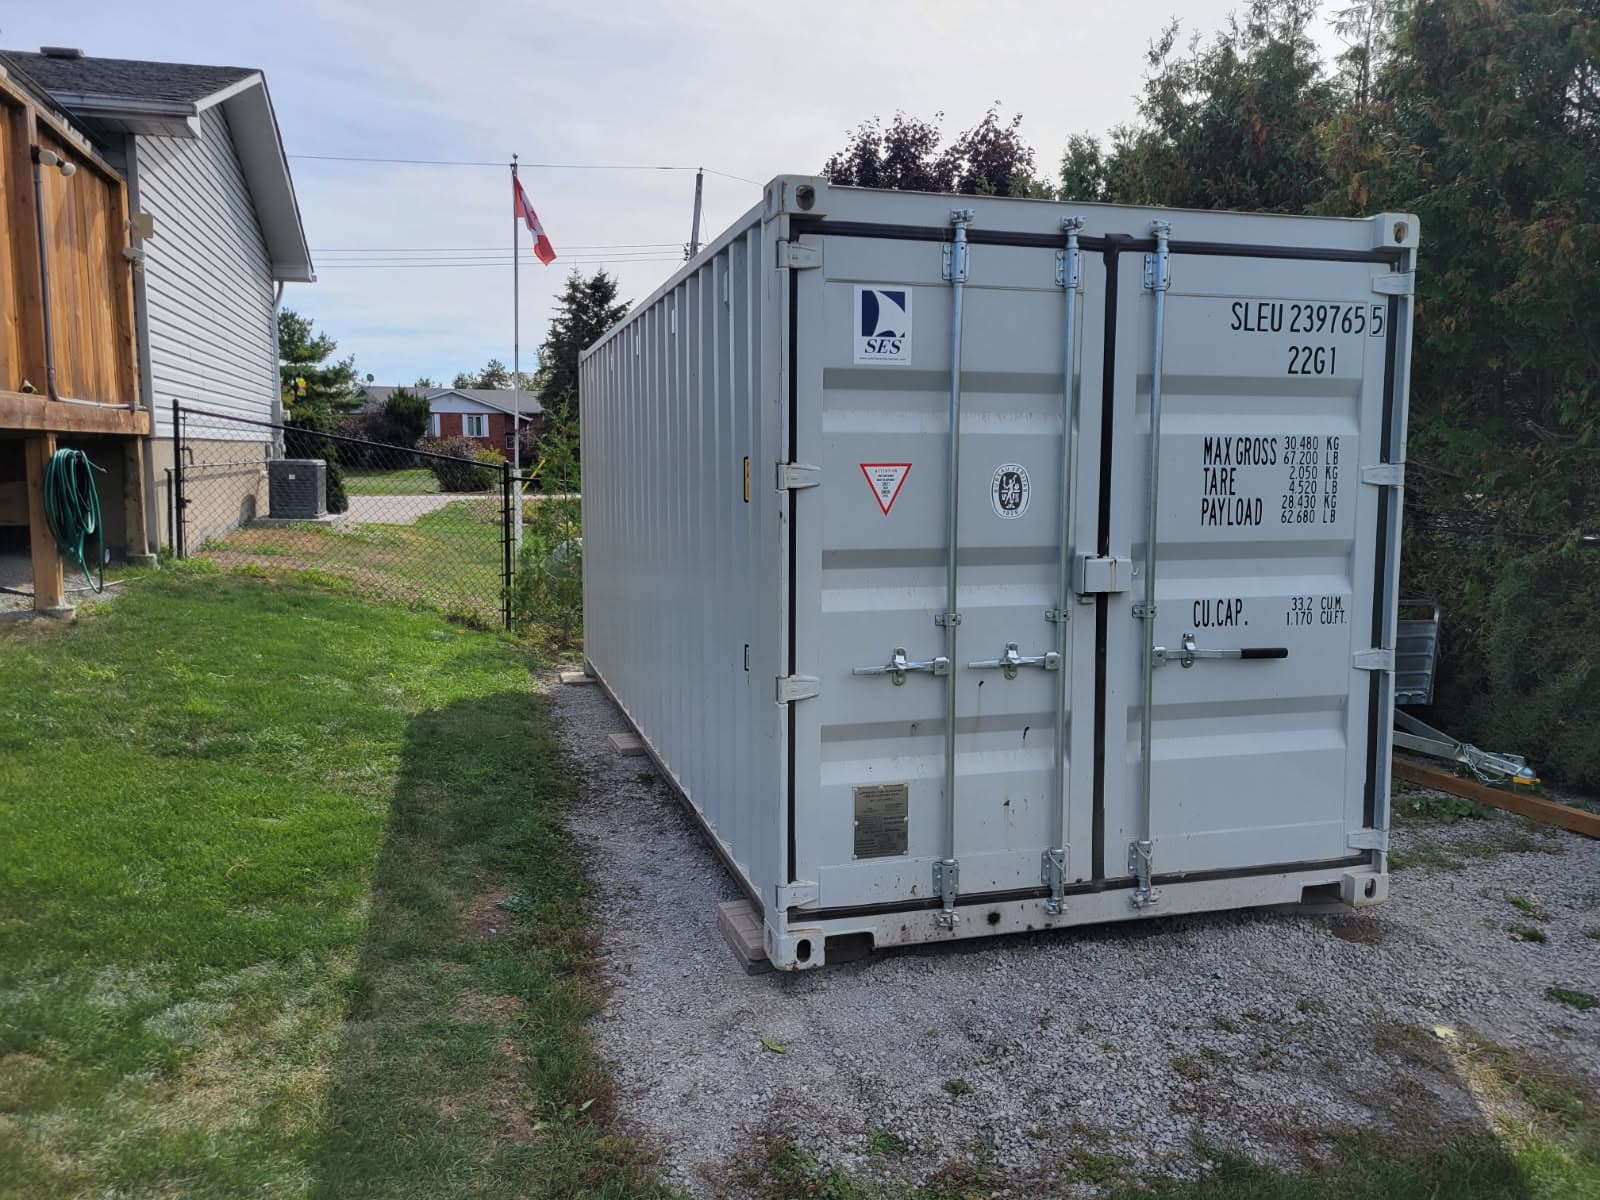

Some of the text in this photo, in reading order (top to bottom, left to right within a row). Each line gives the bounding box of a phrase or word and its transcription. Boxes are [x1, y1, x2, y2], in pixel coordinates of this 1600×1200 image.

[1231, 302, 1383, 335] SLEU 239765 5
[864, 338, 902, 355] SES
[1287, 346, 1336, 375] 22G1
[1284, 436, 1340, 451] 30.480 KG
[1203, 437, 1278, 466] MAX GROSS
[1283, 451, 1339, 465] 67.200 LB
[1289, 466, 1338, 480] 2.050 KG
[1203, 467, 1237, 496] TARE
[1288, 481, 1338, 495] 4.520 LB
[1281, 495, 1337, 509] 28.430 KG
[1201, 498, 1263, 526] PAYLOAD
[1280, 510, 1336, 524] 62.680 LB
[1291, 597, 1313, 611] 33.2
[1286, 611, 1313, 626] 1.170
